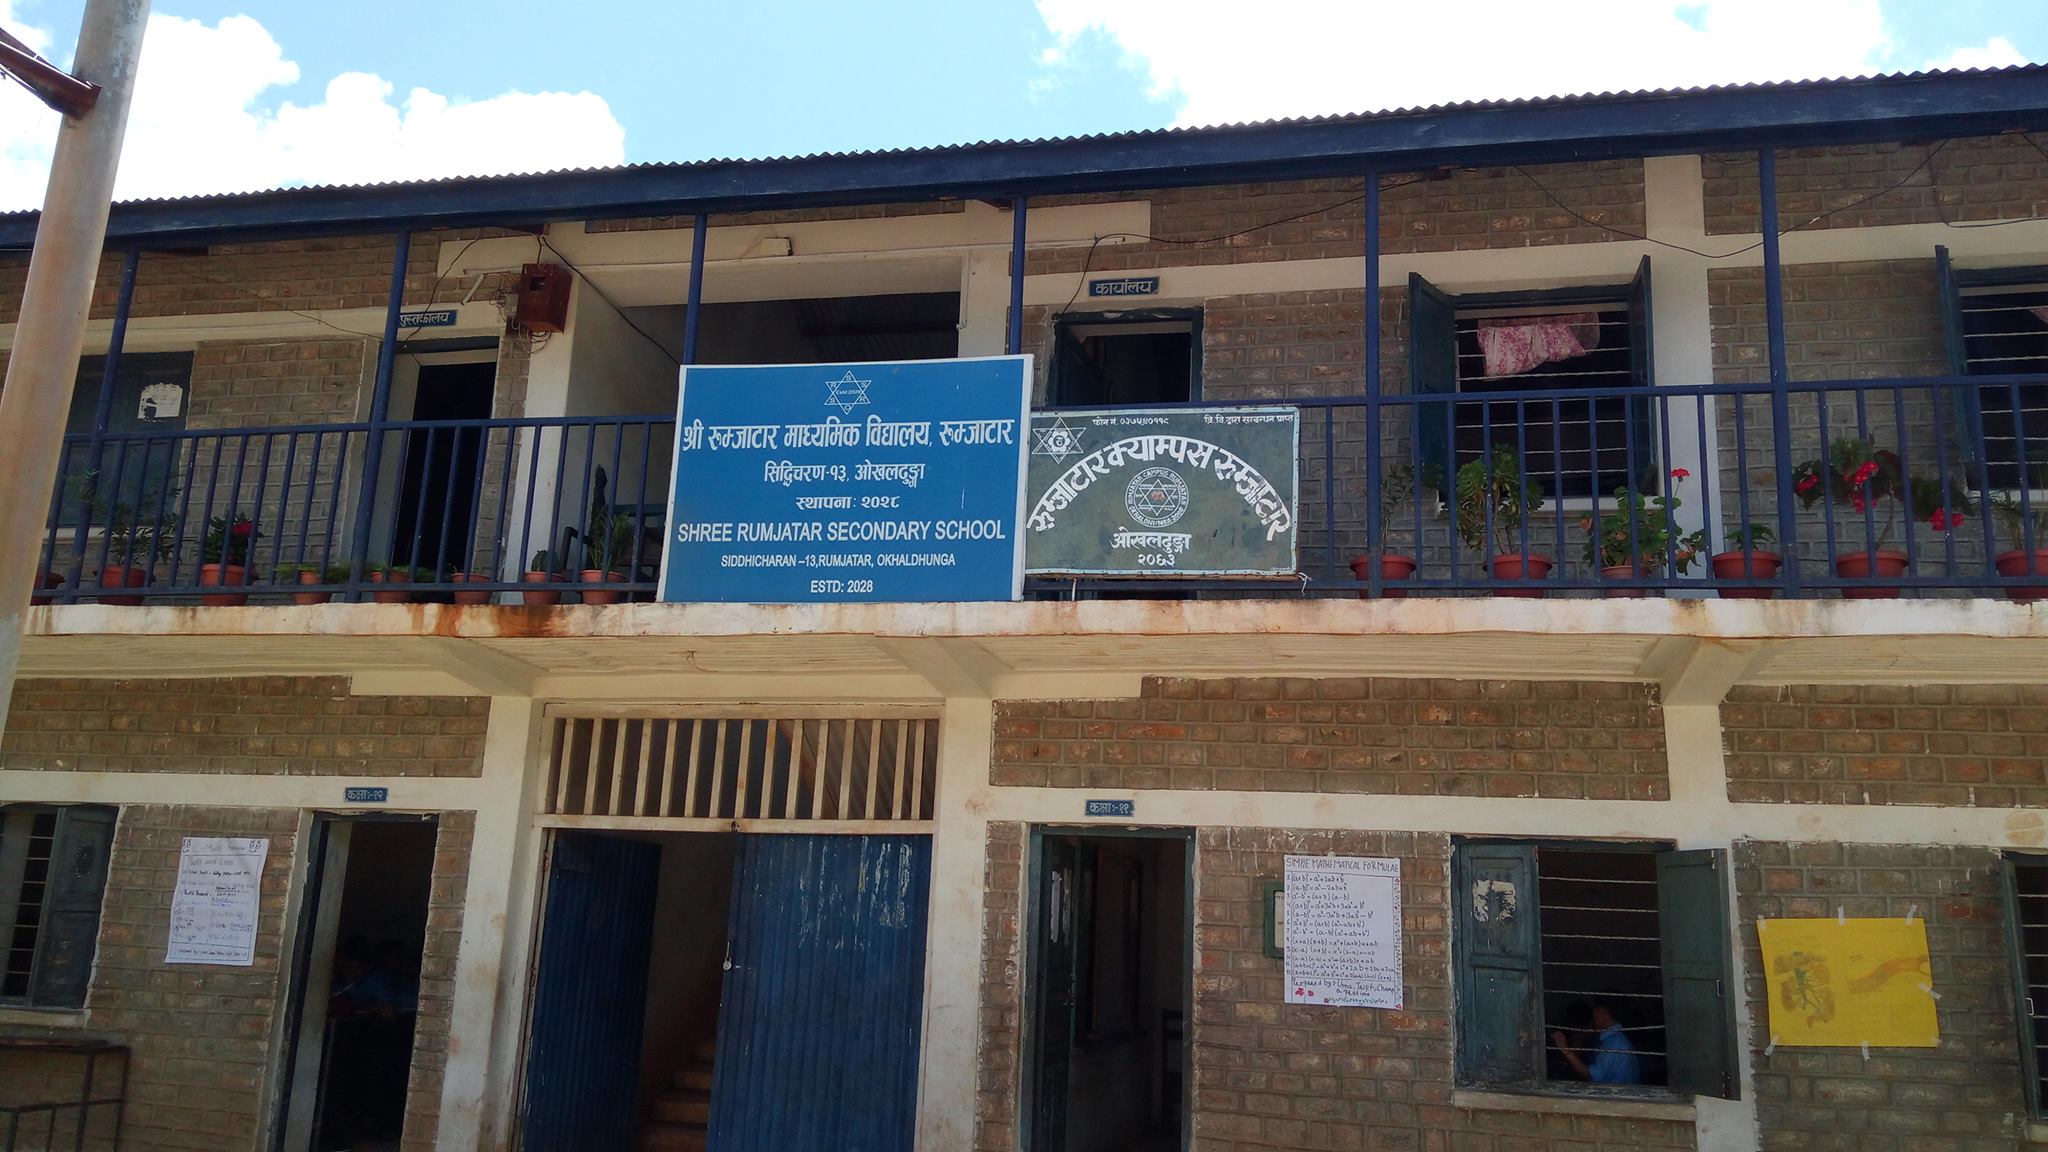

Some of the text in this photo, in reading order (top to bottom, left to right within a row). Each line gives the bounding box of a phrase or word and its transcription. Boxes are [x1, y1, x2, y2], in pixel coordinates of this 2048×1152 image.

[1095, 279, 1153, 295] कार्यालय
[683, 418, 704, 451] श्री
[783, 415, 862, 448] माध्यमिक
[1102, 435, 1219, 470] क्याम्पस
[861, 496, 900, 509] २०२८
[678, 520, 1005, 542] SHREE RUMJATAR SECONDARY SCHOOL
[721, 555, 797, 568] SIDDHICHARAN
[877, 553, 956, 566] OKHALDHUNGA
[1138, 553, 1175, 567] २०६३
[810, 579, 873, 593] ESTD: 2028
